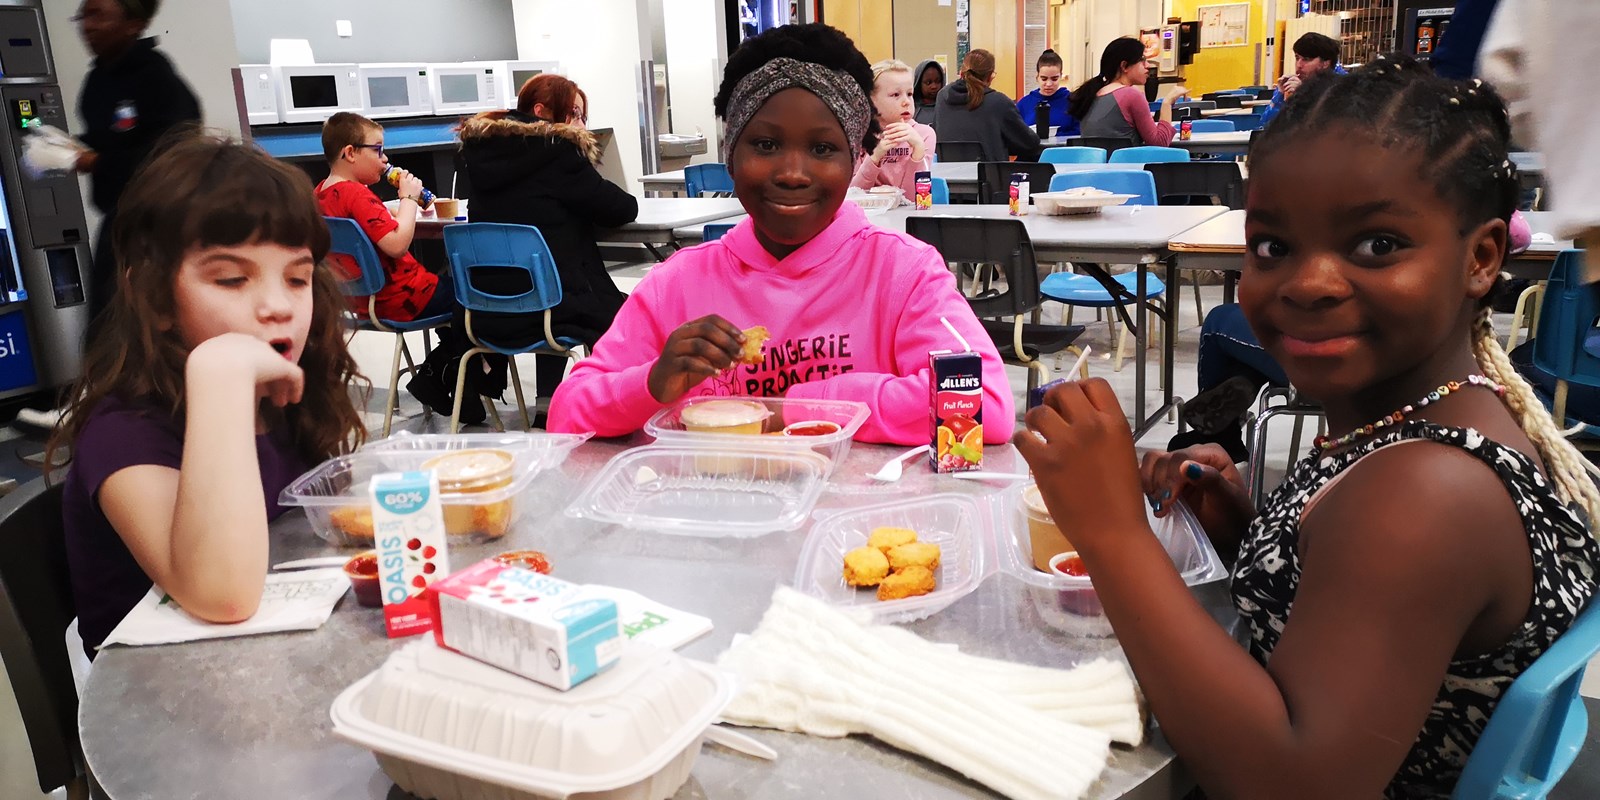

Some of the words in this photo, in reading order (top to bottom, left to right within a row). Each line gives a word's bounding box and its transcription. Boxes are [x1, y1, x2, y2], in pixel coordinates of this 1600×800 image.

[886, 148, 909, 156] ROMBIE
[940, 377, 980, 389] ALLEN'S
[943, 401, 957, 411] Fruit
[957, 399, 974, 409] Punch
[384, 491, 424, 506] 60%
[380, 535, 408, 605] OASIS
[497, 569, 567, 597] OASIS
